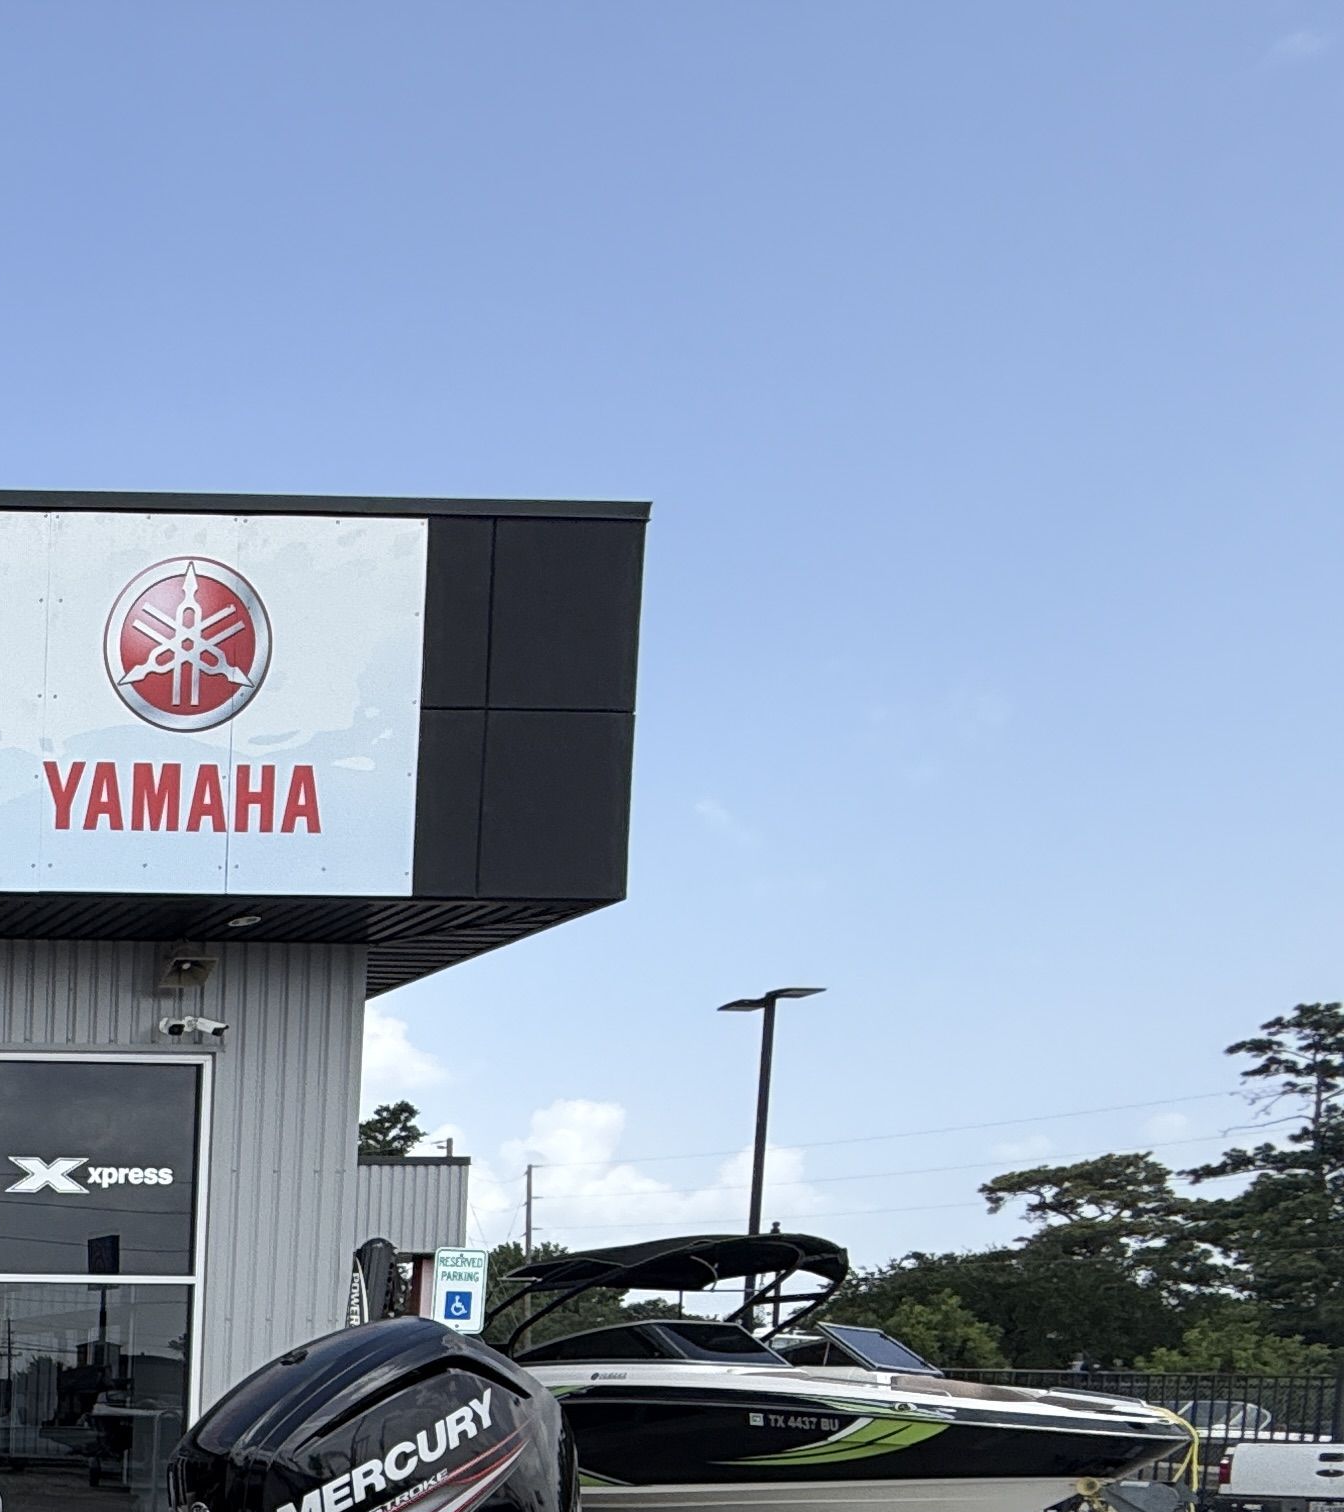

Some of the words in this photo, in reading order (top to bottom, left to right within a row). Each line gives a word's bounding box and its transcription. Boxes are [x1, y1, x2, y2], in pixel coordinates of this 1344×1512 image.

[43, 761, 321, 834] YAMAHA
[87, 1166, 174, 1188] xpress
[439, 1256, 483, 1268] RESERVED
[440, 1270, 480, 1281] PARKING
[349, 1272, 361, 1328] POWER
[768, 1415, 786, 1428] TX
[821, 1418, 840, 1431] BU
